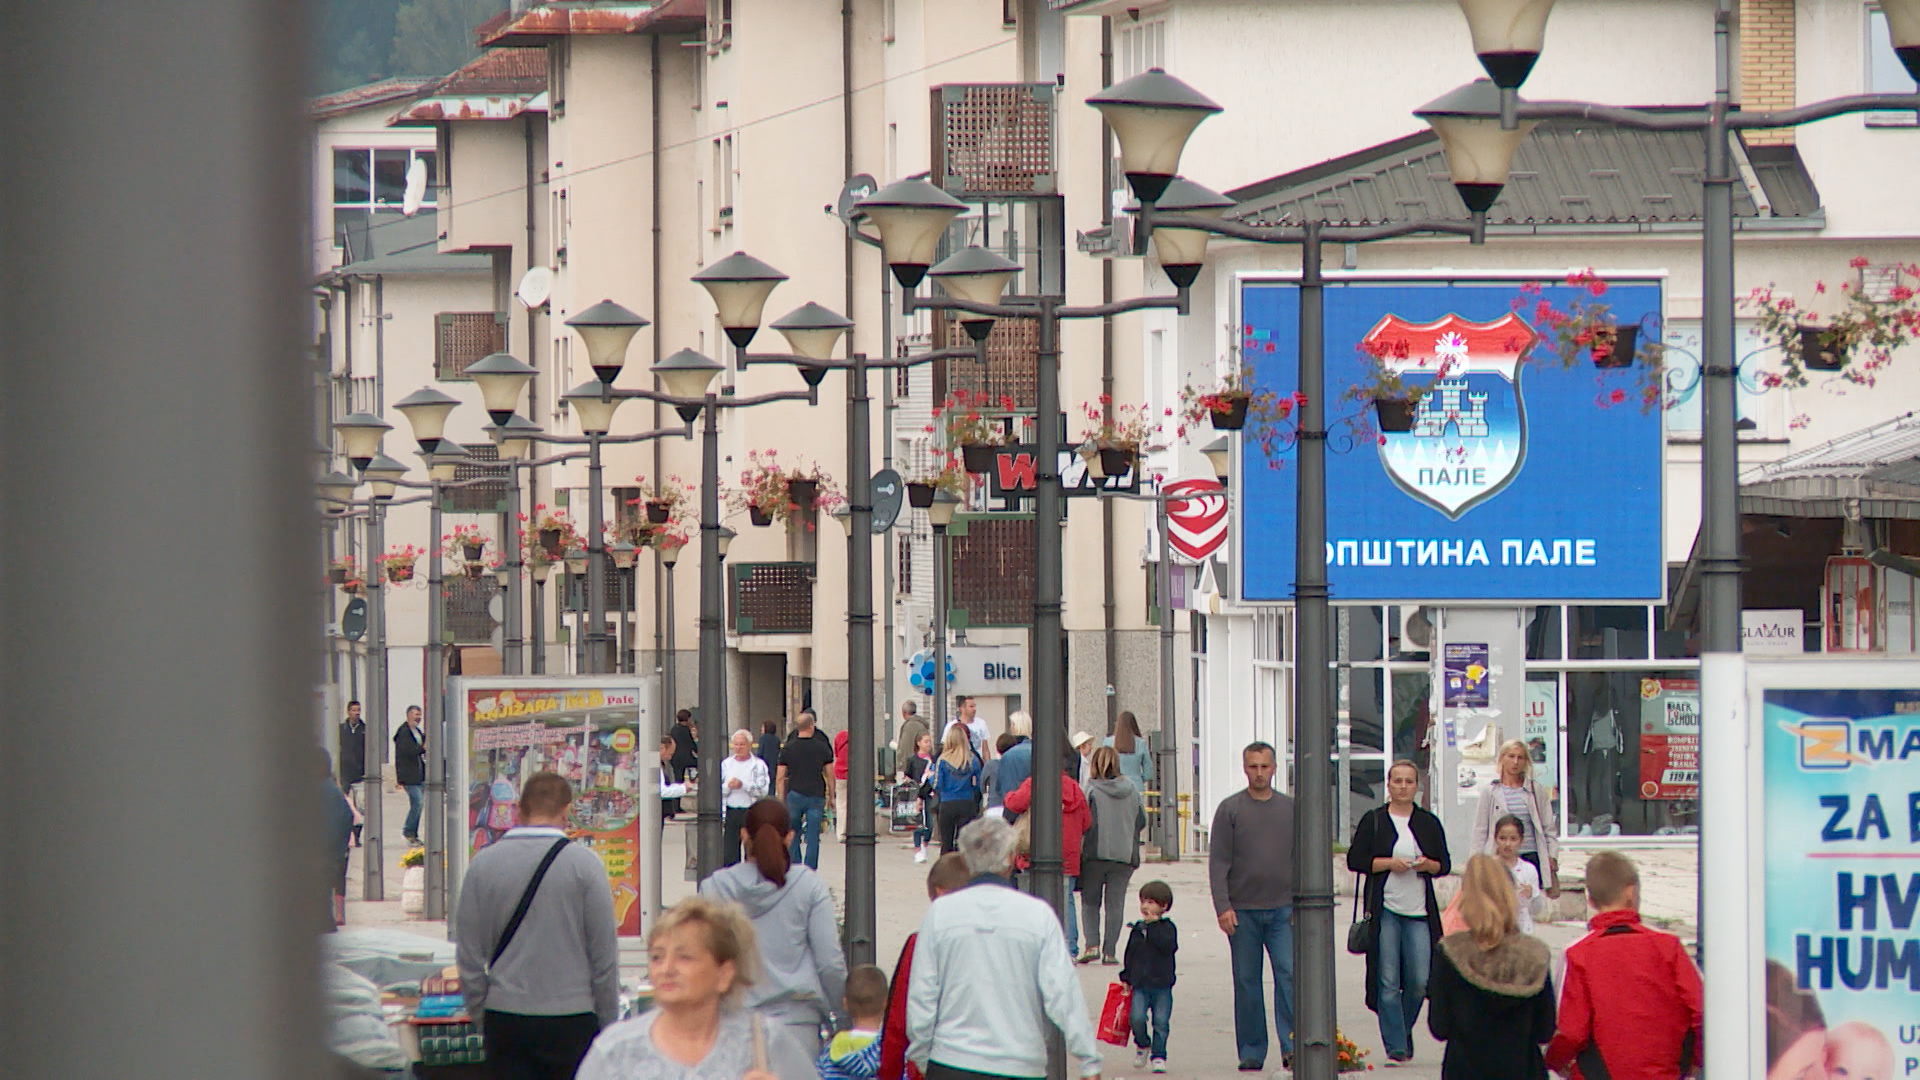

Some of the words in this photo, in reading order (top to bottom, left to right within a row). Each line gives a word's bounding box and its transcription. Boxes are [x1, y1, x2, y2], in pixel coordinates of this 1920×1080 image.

[1418, 467, 1486, 486] ПАЛЕ
[1502, 538, 1597, 566] ПАЛЕ
[1857, 728, 1920, 760] MA
[1819, 793, 1891, 843] ZA
[1836, 871, 1920, 931] HV
[1795, 933, 1920, 991] HUM
